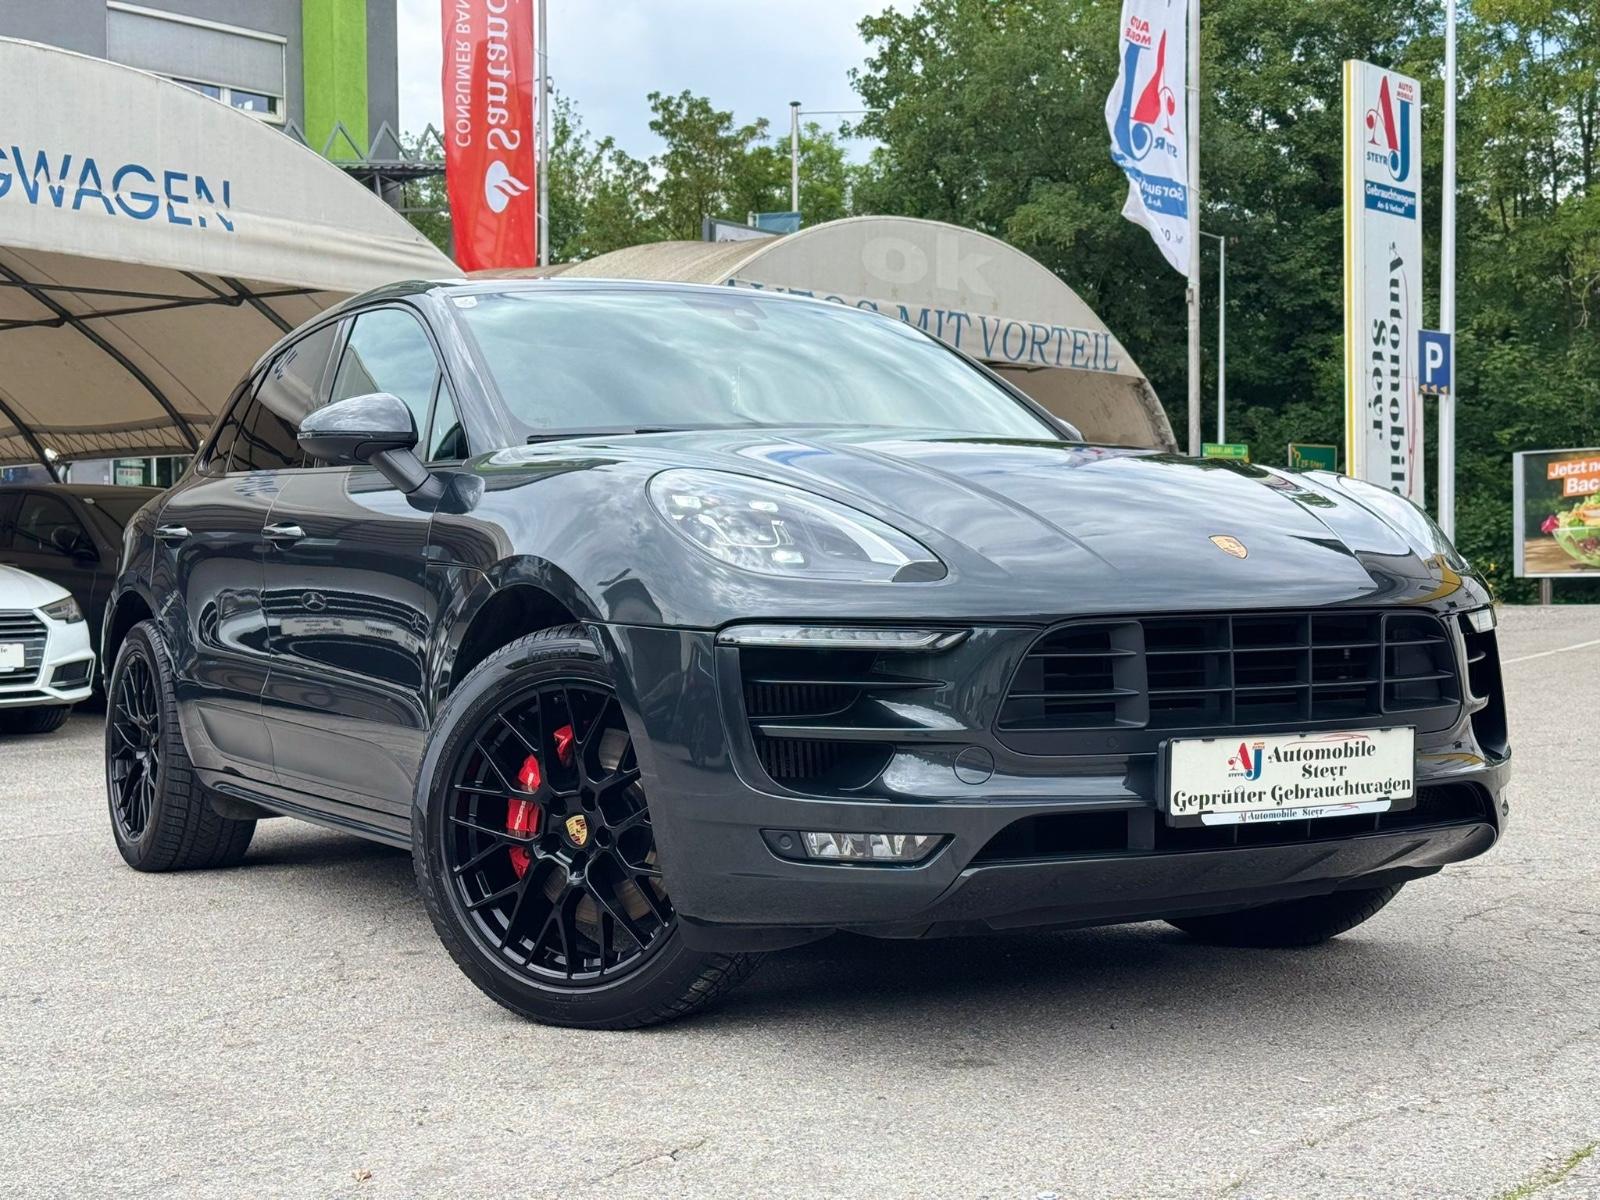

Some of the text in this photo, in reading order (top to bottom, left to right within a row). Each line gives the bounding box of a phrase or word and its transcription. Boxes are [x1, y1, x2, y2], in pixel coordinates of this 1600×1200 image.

[1366, 150, 1388, 165] STEYR
[1365, 183, 1416, 207] Gebrauchtwagen
[978, 315, 1119, 372] VORTEIL
[1425, 341, 1443, 383] P
[1550, 462, 1587, 477] Jetzt
[1268, 741, 1376, 763] Automobile
[1302, 763, 1347, 781] Steyr
[1173, 777, 1411, 811] Geprüfter Gebrauchtwagen
[1248, 808, 1298, 821] Automobile
